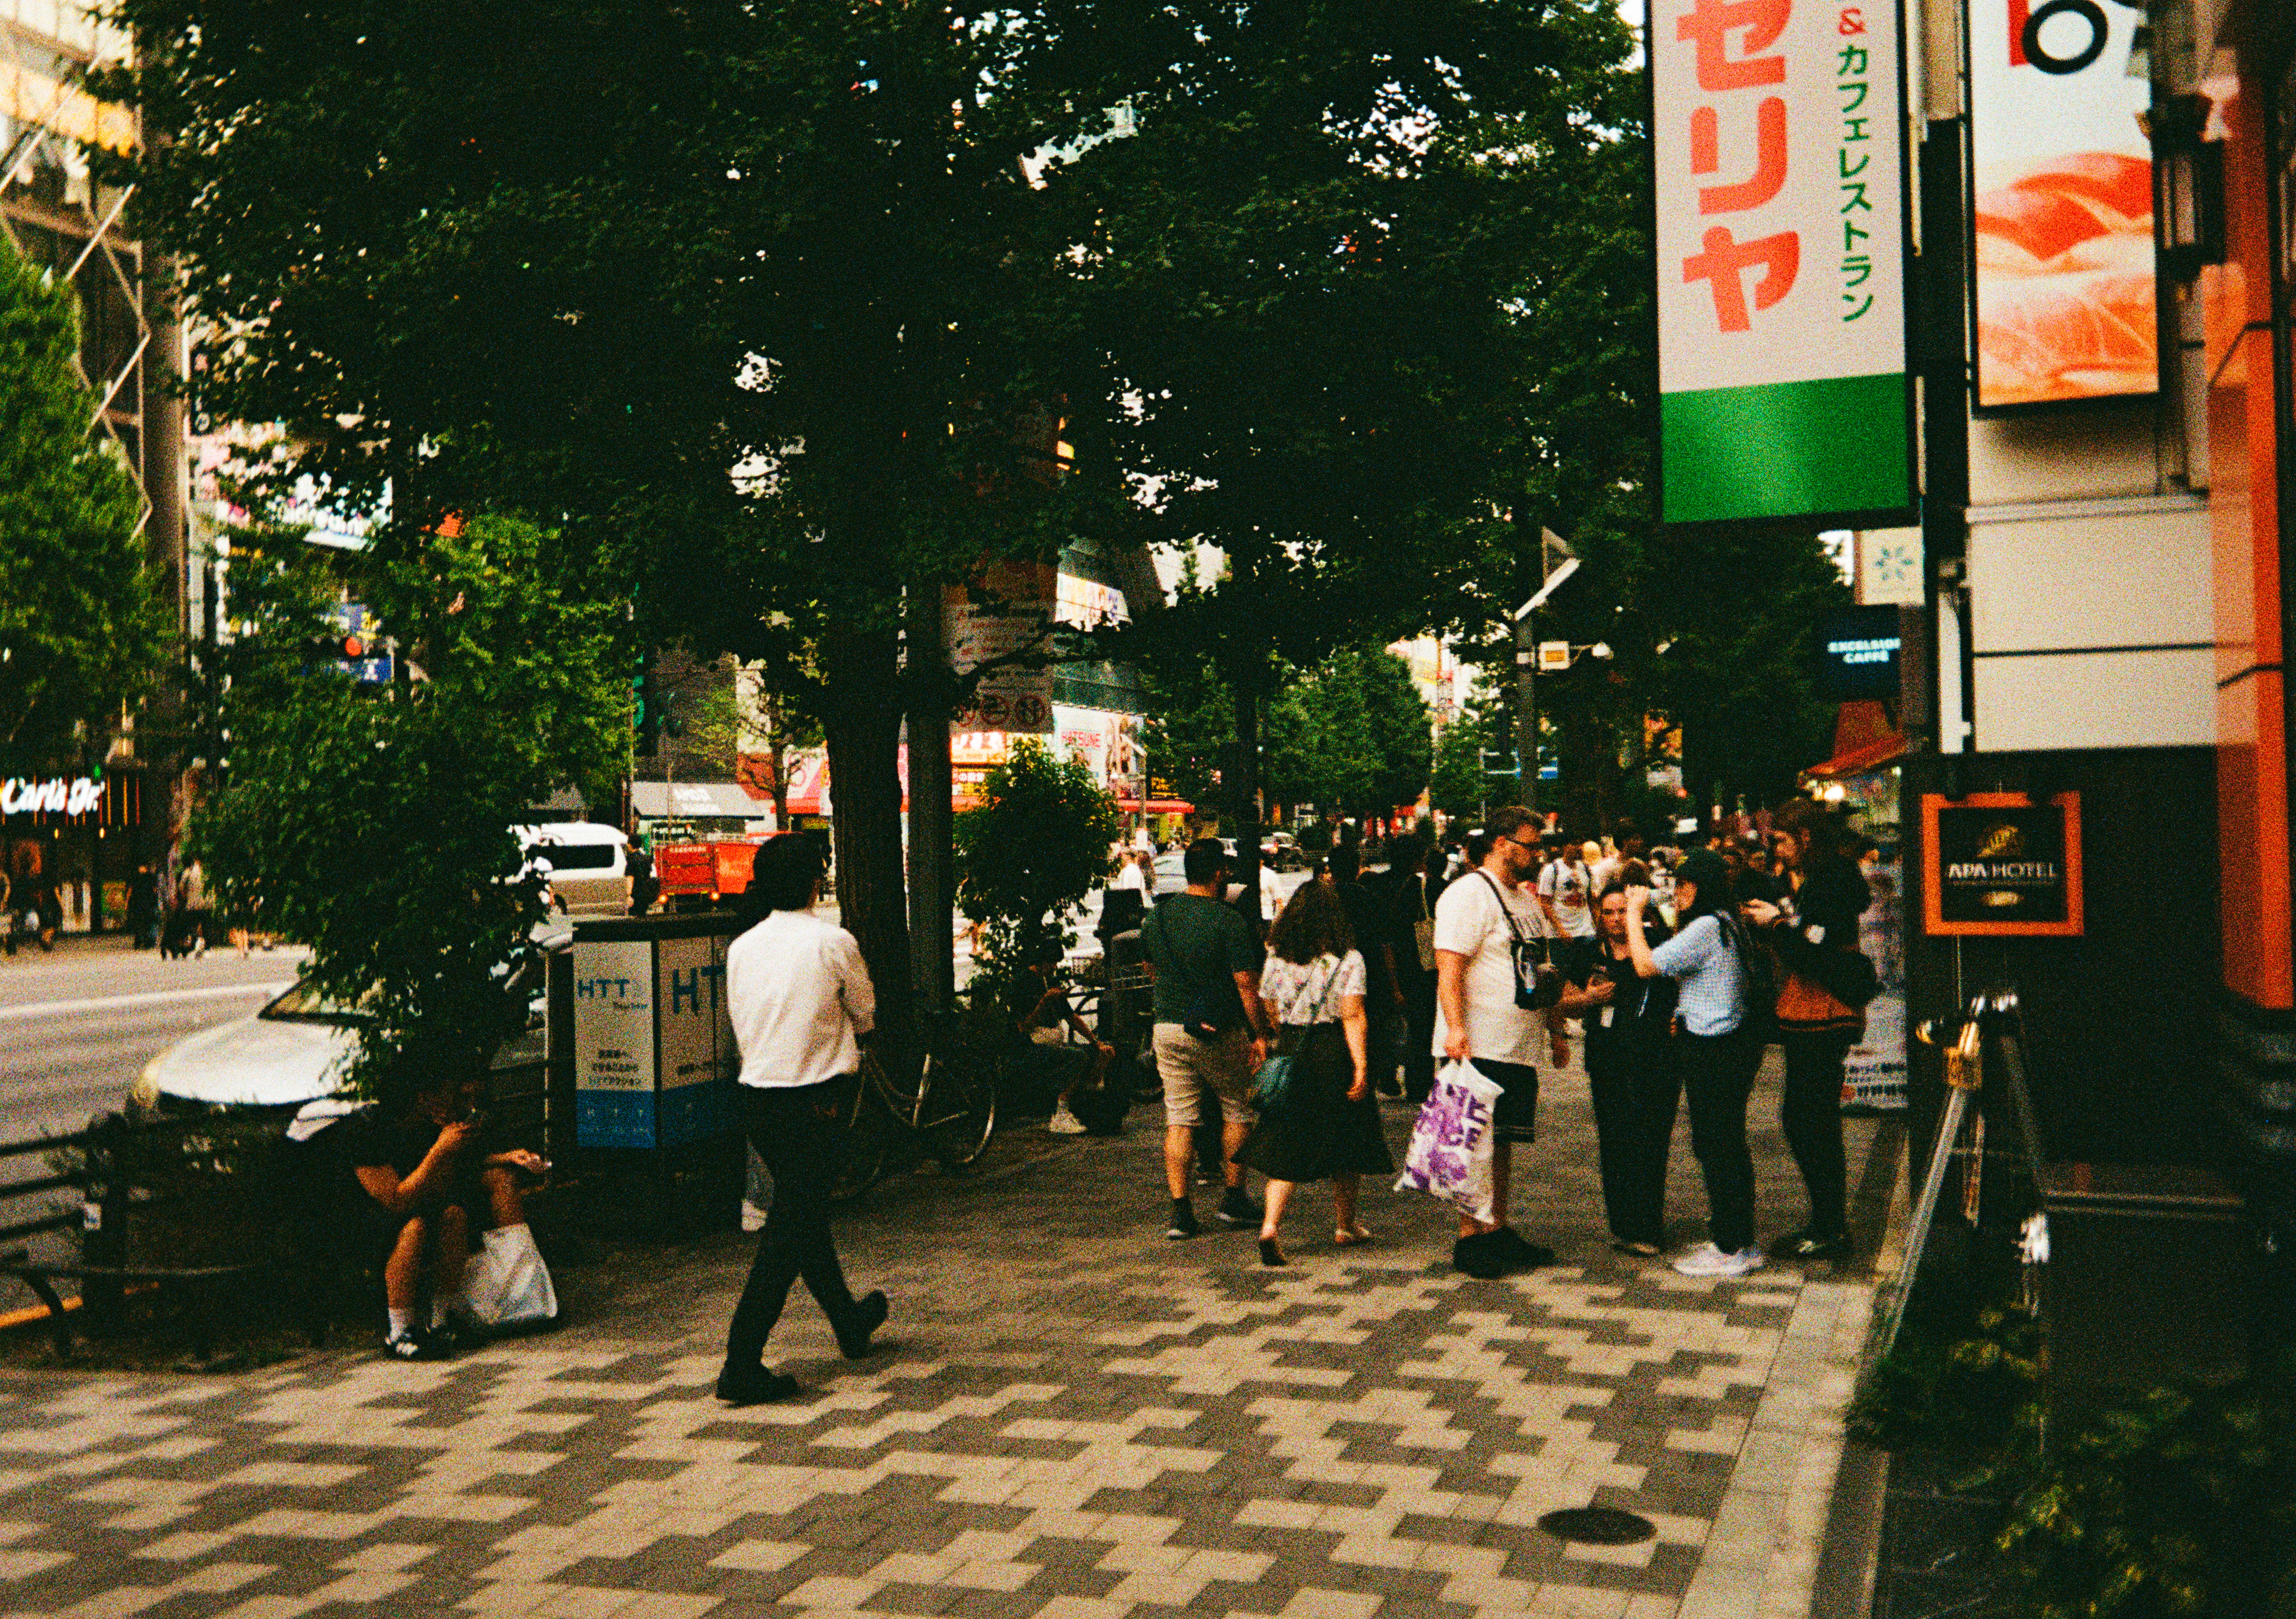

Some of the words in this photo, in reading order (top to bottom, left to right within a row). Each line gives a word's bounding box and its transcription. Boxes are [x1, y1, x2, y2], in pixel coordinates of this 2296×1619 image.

[2, 777, 67, 815] Carl's
[1948, 862, 1988, 879] APA
[1991, 862, 2057, 878] HOTEL
[578, 978, 630, 998] HTT
